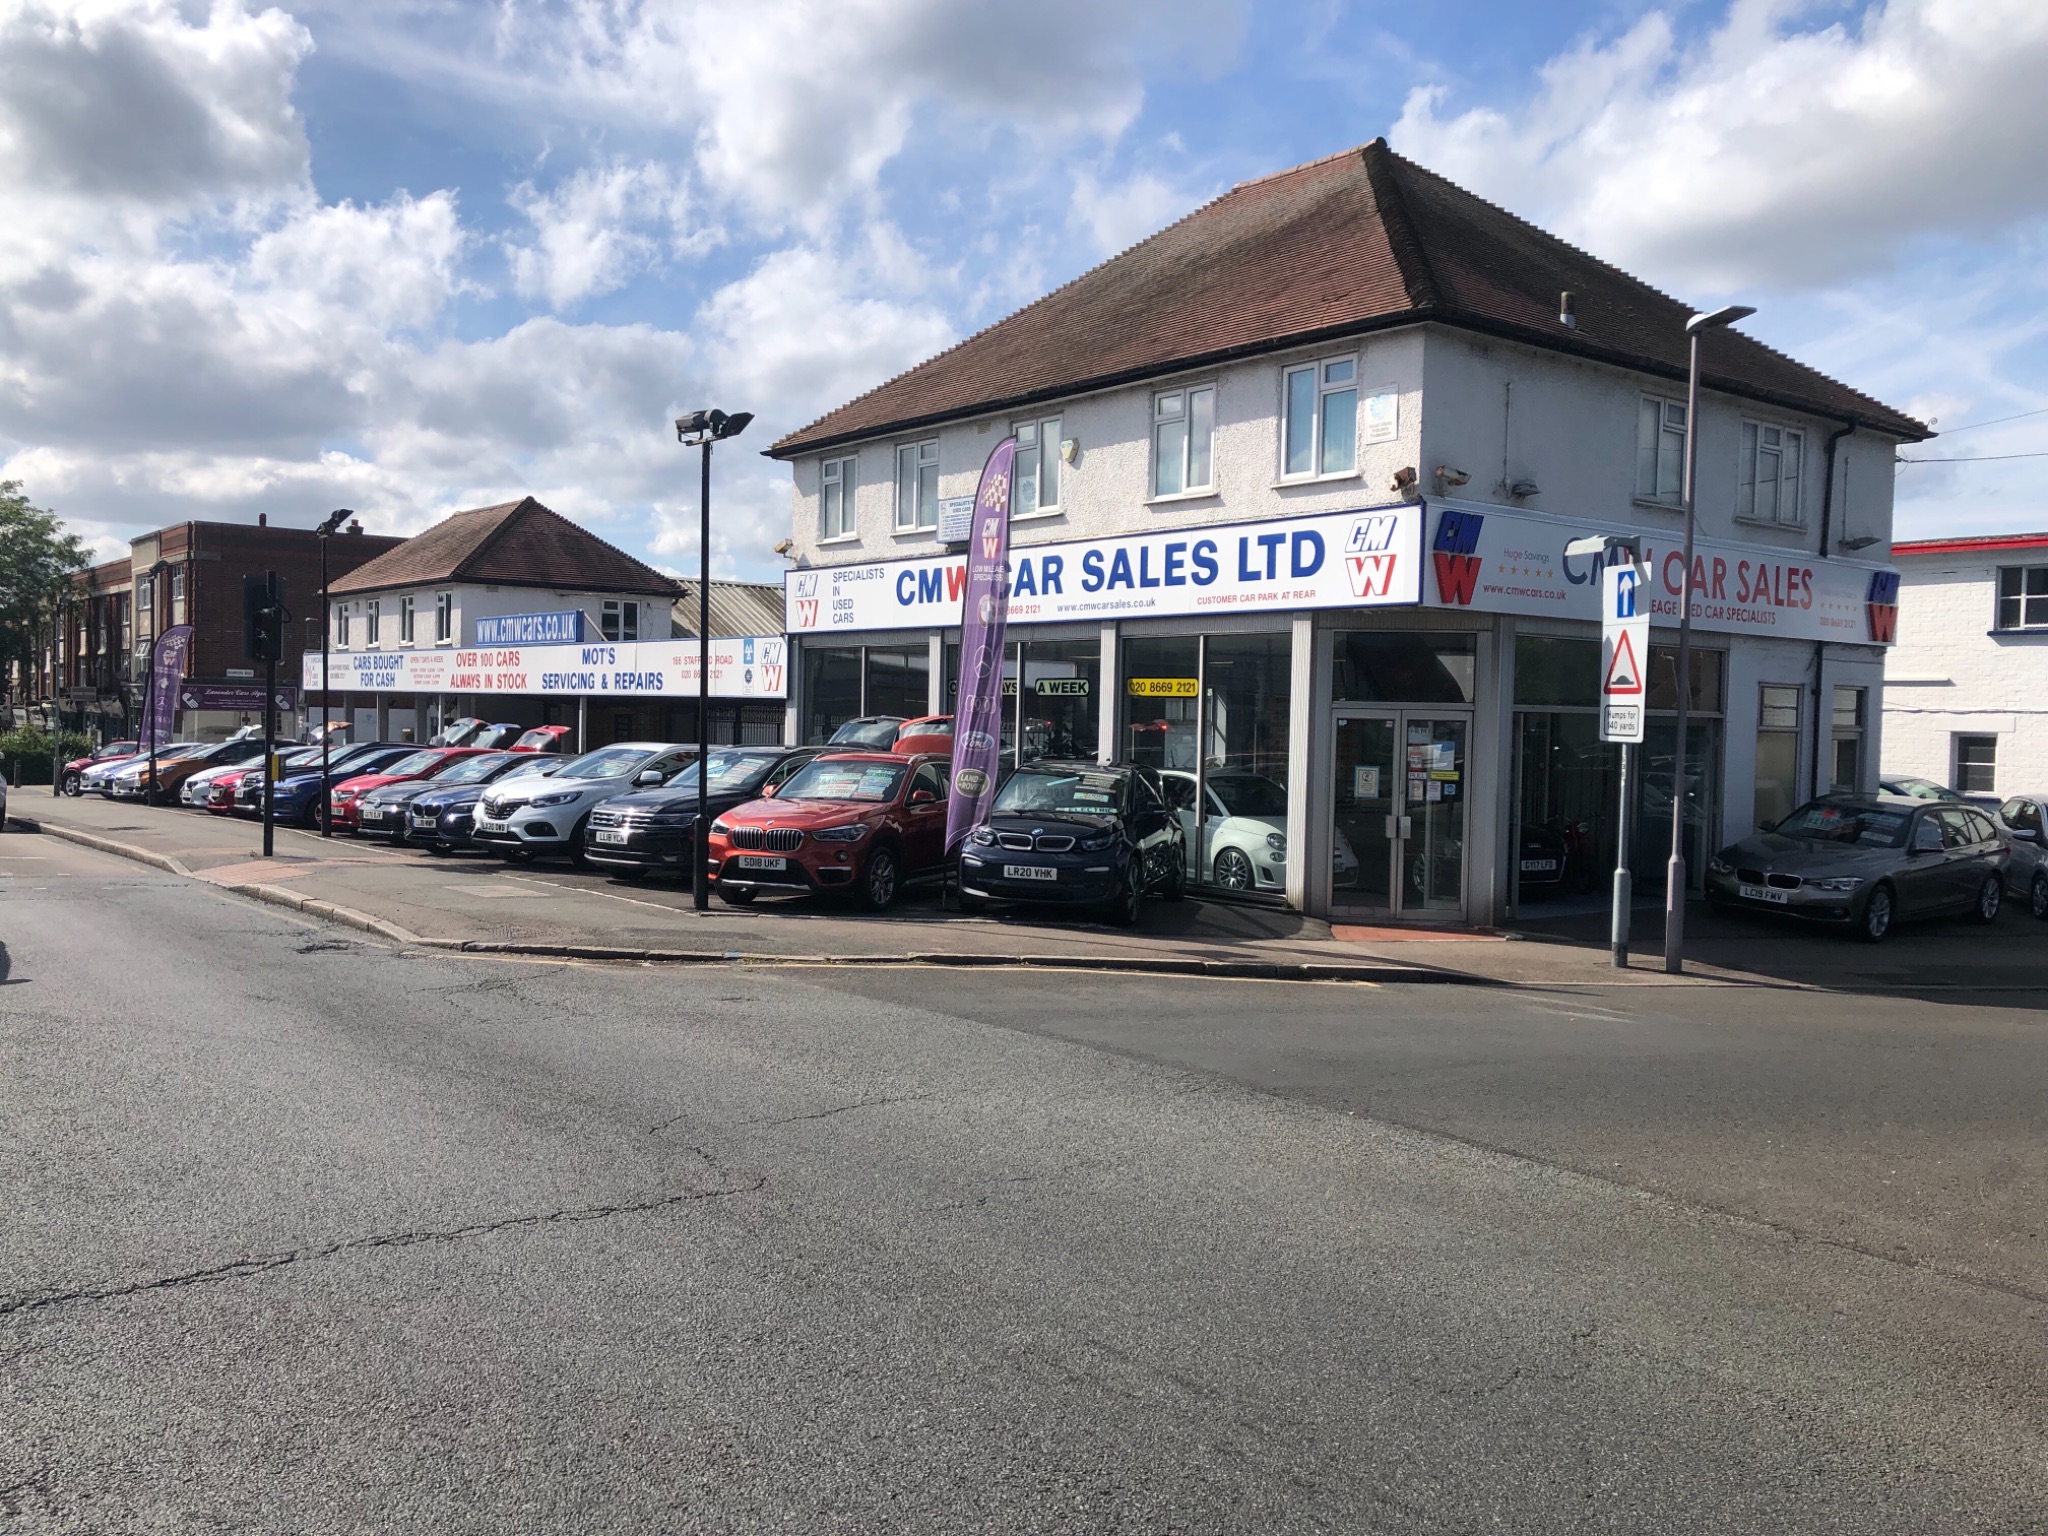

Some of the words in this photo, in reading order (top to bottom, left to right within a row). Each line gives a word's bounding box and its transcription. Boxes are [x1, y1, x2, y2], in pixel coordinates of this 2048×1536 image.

[1081, 539, 1219, 593] SALES
[1238, 530, 1326, 582] LTD
[1503, 547, 1523, 561] Huge
[1524, 549, 1550, 564] Savings
[832, 567, 885, 583] SPECIALISTS
[1345, 554, 1397, 597] W
[1663, 550, 1727, 600] CAR
[1737, 560, 1814, 610] SALES
[832, 586, 841, 597] IN
[1197, 594, 1238, 605] CUSTOMER
[1240, 593, 1256, 603] CAR
[1258, 591, 1279, 602] PARK
[1281, 591, 1291, 600] AT
[1293, 589, 1316, 600] REAR
[1483, 583, 1567, 600] www.cmwcars.co.uk
[832, 598, 854, 611] USED
[1025, 604, 1041, 614] 2121
[1056, 597, 1156, 612] www.cmwcarsales.co.uk
[832, 612, 854, 624] CARS
[1704, 606, 1725, 620] CAR
[1726, 607, 1776, 625] SPECIALISTS
[476, 614, 575, 643] www.cmwcars.co.uk
[353, 655, 372, 670] CARS
[373, 654, 404, 670] BOUGHT
[456, 652, 478, 667] OVER
[480, 652, 494, 667] 100
[496, 650, 520, 667] CARS
[582, 647, 615, 665] MOT'S
[684, 655, 713, 665] STAFFD
[715, 655, 734, 665] ROAD
[360, 672, 375, 687] FOR
[375, 672, 396, 687] CASH
[449, 673, 481, 689] ALWAYS
[484, 673, 493, 689] IN
[497, 673, 528, 689] STOCK
[541, 673, 595, 690] SERVICING
[601, 673, 608, 689] &
[614, 672, 663, 690] REPAIRS
[1129, 682, 1147, 692] 020
[1149, 682, 1173, 692] 8669
[1176, 682, 1196, 693] 2121
[1037, 682, 1046, 694] A
[1049, 682, 1087, 694] WEEK
[1607, 710, 1627, 721] Humps
[1627, 710, 1637, 720] for
[1619, 722, 1635, 732] yards
[965, 733, 989, 750] Ford
[744, 857, 763, 868] SD18
[764, 858, 781, 869] UKF
[1007, 866, 1032, 878] LR20
[1034, 868, 1053, 879] VHK
[1744, 887, 1764, 898] LC19
[1765, 891, 1783, 901] FMV
